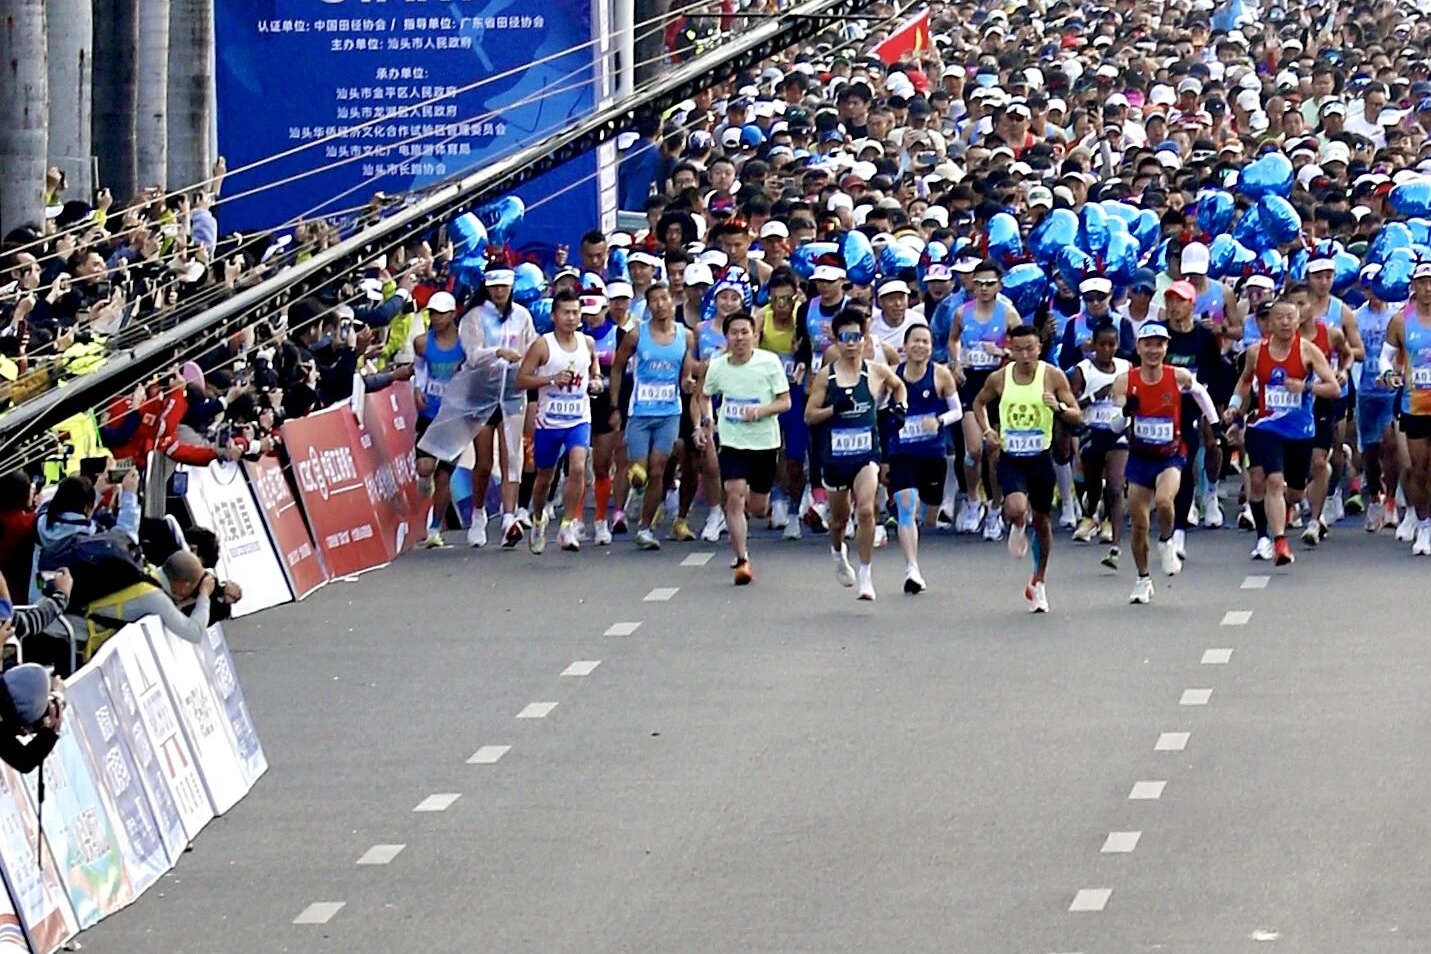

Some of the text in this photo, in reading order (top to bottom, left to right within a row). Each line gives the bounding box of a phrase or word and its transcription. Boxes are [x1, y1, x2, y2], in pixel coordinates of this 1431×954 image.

[335, 85, 458, 101] 汕头市金平区人民政府
[361, 162, 448, 177] 汕头市长跑协会
